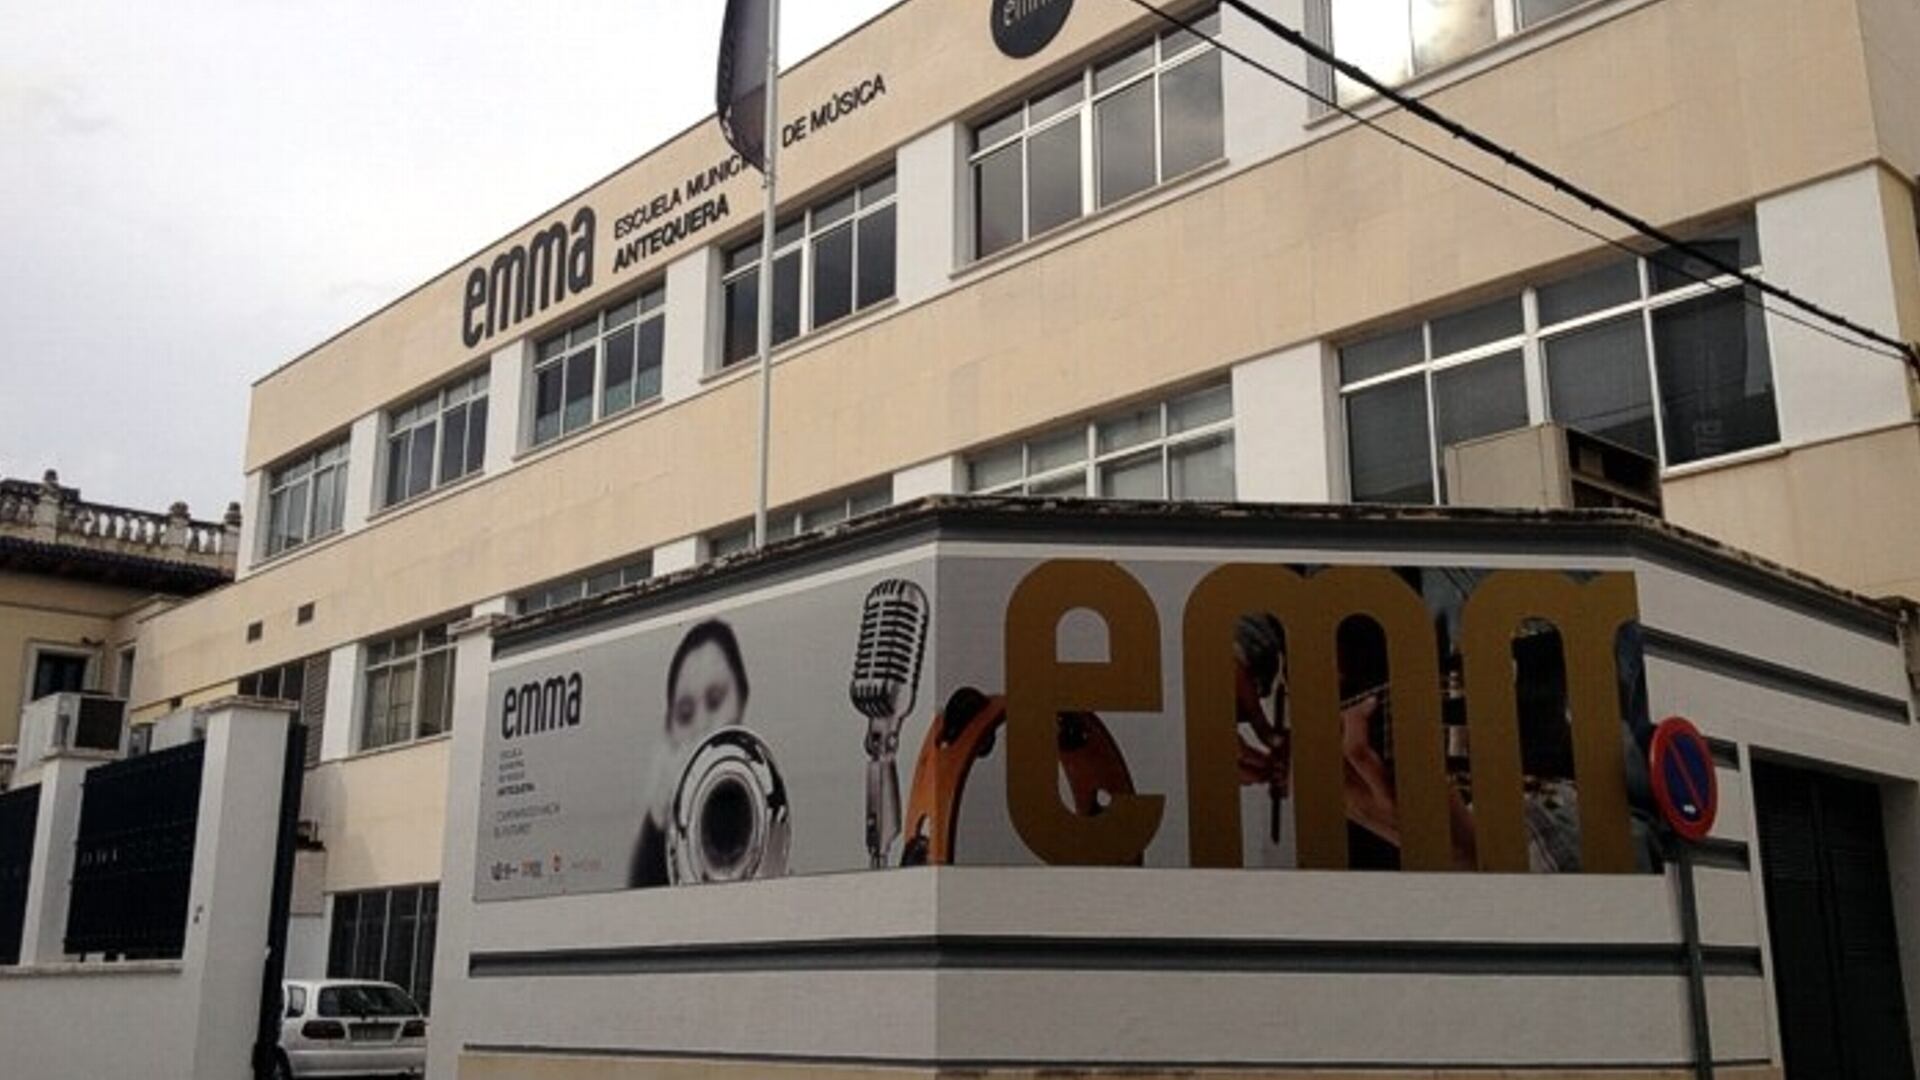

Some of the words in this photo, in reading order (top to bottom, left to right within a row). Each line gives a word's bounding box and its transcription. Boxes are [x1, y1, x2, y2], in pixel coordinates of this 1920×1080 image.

[614, 187, 683, 240] ESCUELA
[686, 154, 749, 201] MUNICI
[782, 115, 807, 148] DE
[810, 73, 886, 132] MÚSICA
[462, 205, 597, 349] emma
[613, 192, 730, 274] ANTEQUERA
[501, 671, 583, 740] emma
